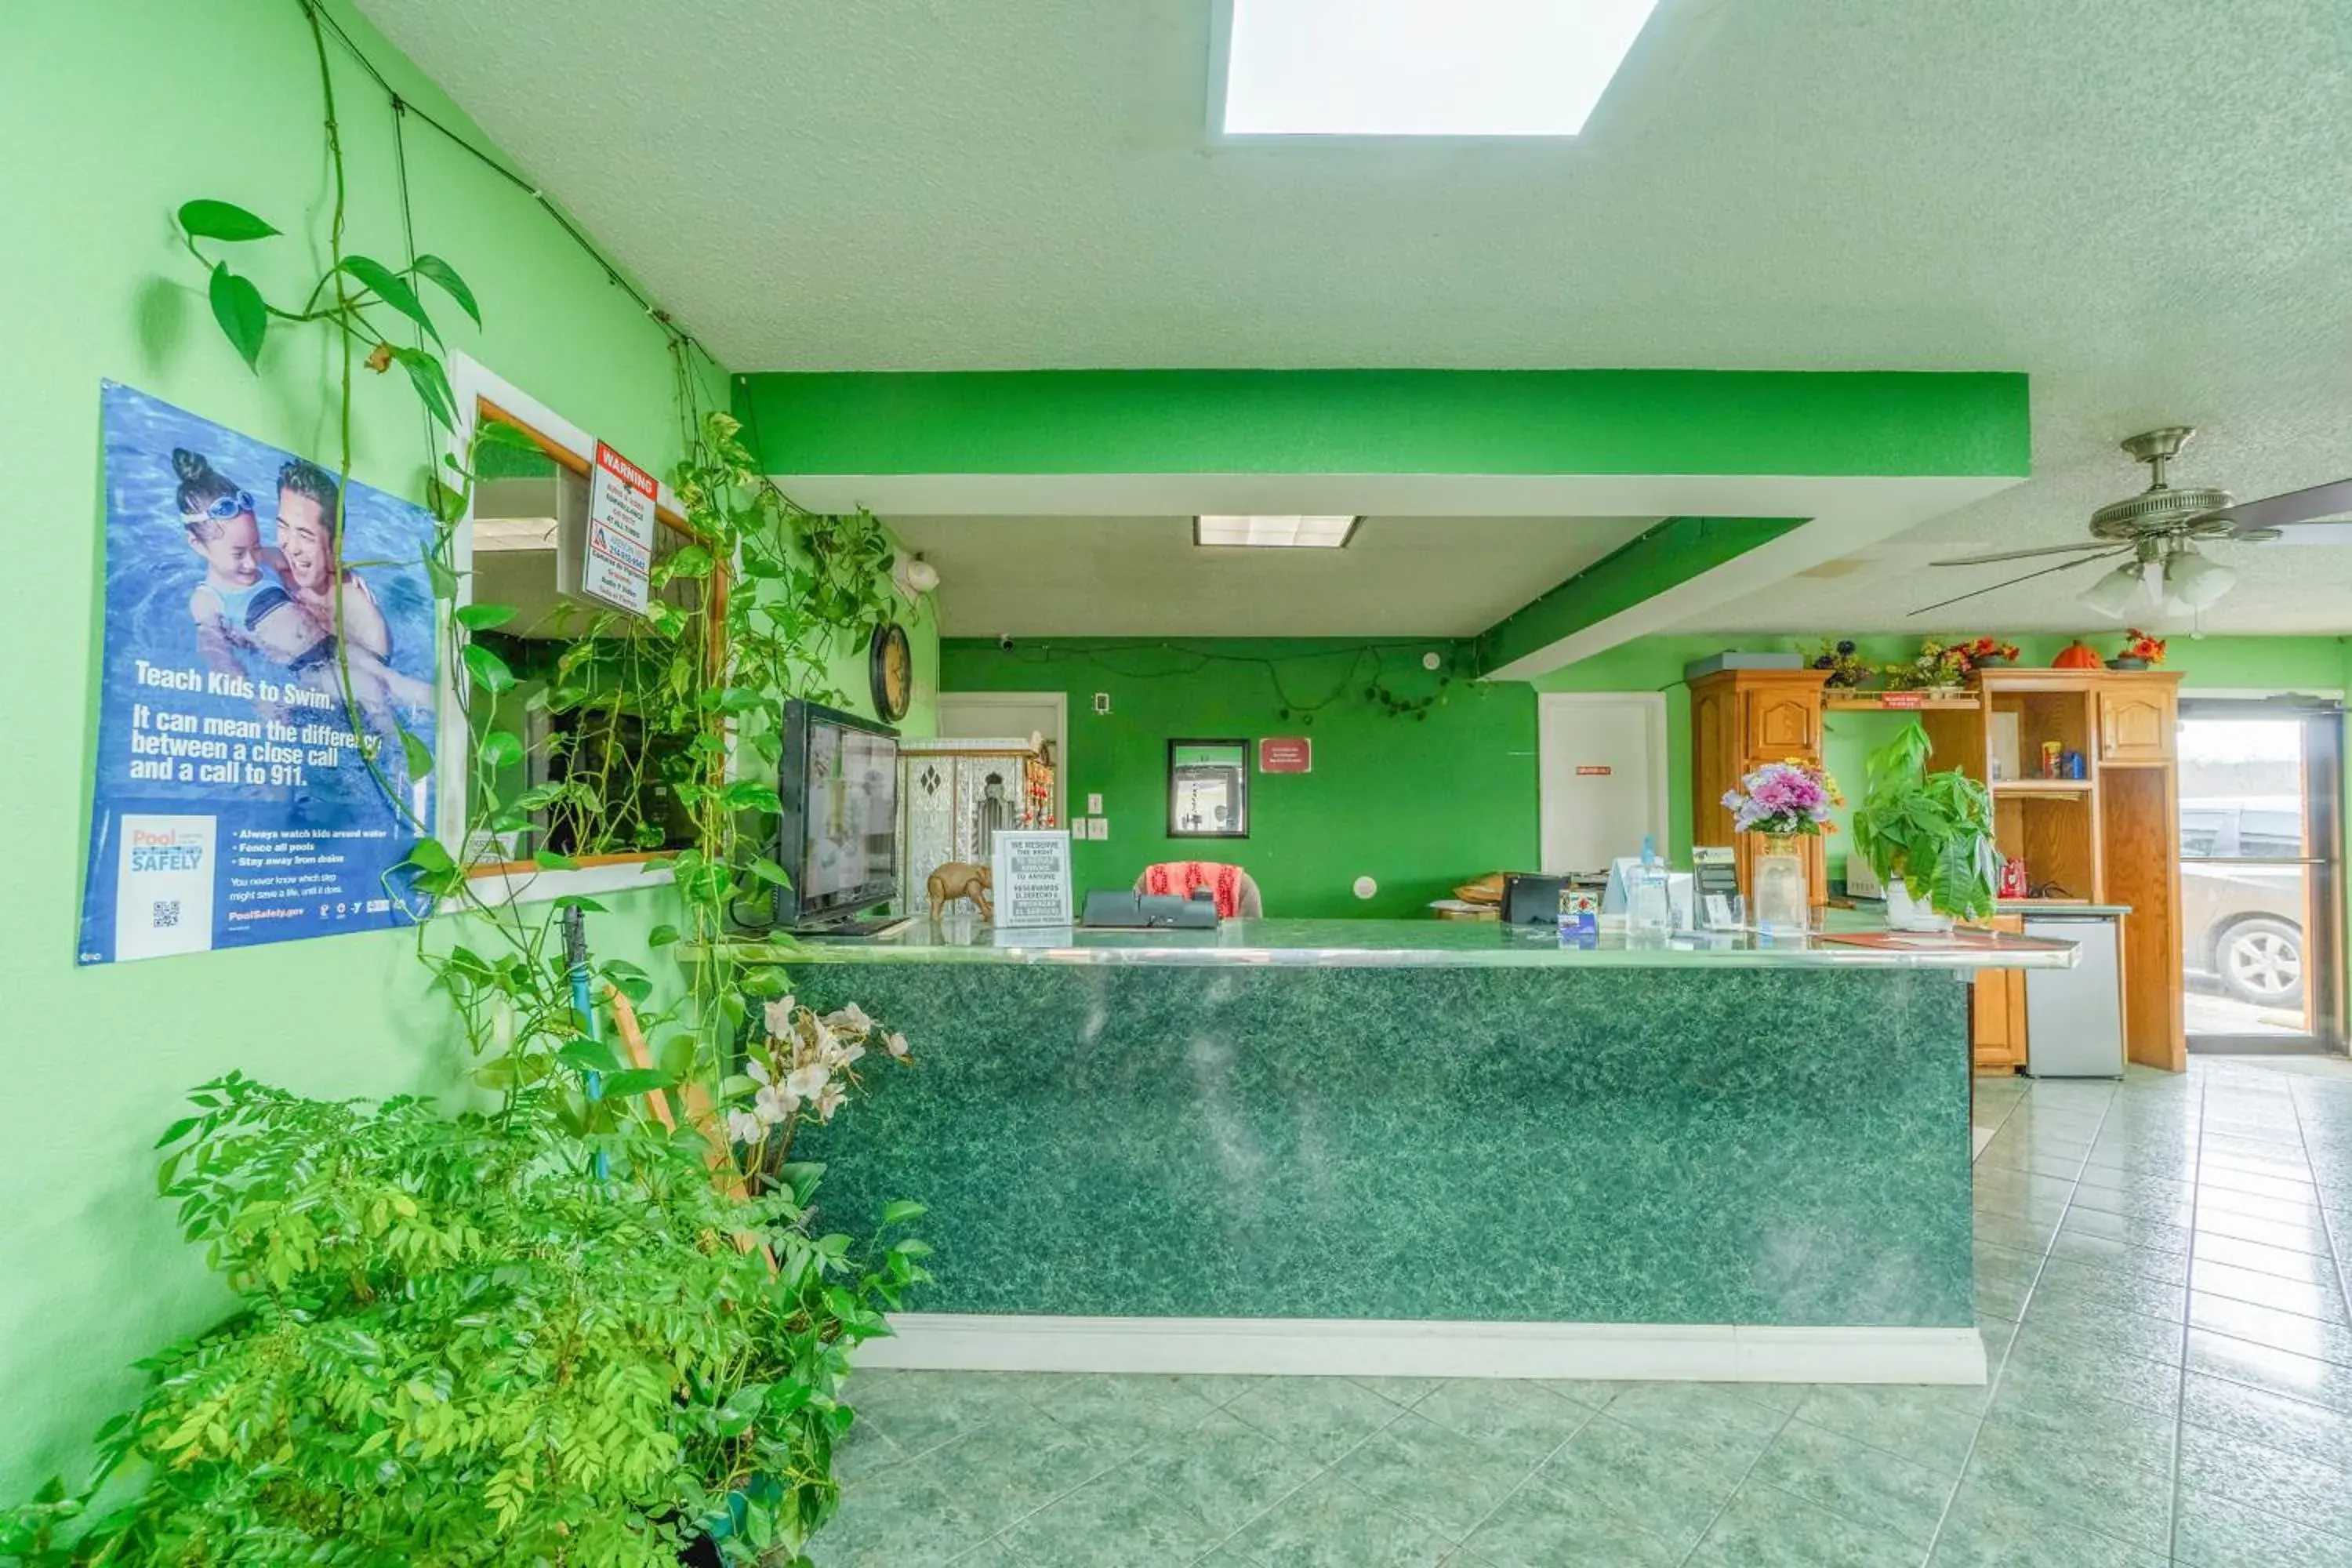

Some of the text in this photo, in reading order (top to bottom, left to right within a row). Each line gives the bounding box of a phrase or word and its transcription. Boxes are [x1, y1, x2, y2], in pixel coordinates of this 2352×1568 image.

[603, 449, 653, 493] WARNING
[135, 659, 336, 710] Teach Kids to Swim.
[133, 703, 151, 729] It
[157, 712, 198, 733] can
[203, 717, 260, 739] mean
[266, 720, 297, 742] the
[131, 728, 339, 768] between a close call
[129, 757, 308, 786] and a call to 911.
[132, 829, 176, 846] Pool
[239, 829, 387, 840] Always watch kids around water
[239, 842, 314, 854] Fence all pools
[132, 855, 201, 872] SAFELY
[238, 854, 344, 868] Stay away from drains
[231, 877, 248, 887] You
[275, 876, 296, 884] know
[230, 891, 255, 902] might
[228, 908, 304, 922] PoolSafely.gov
